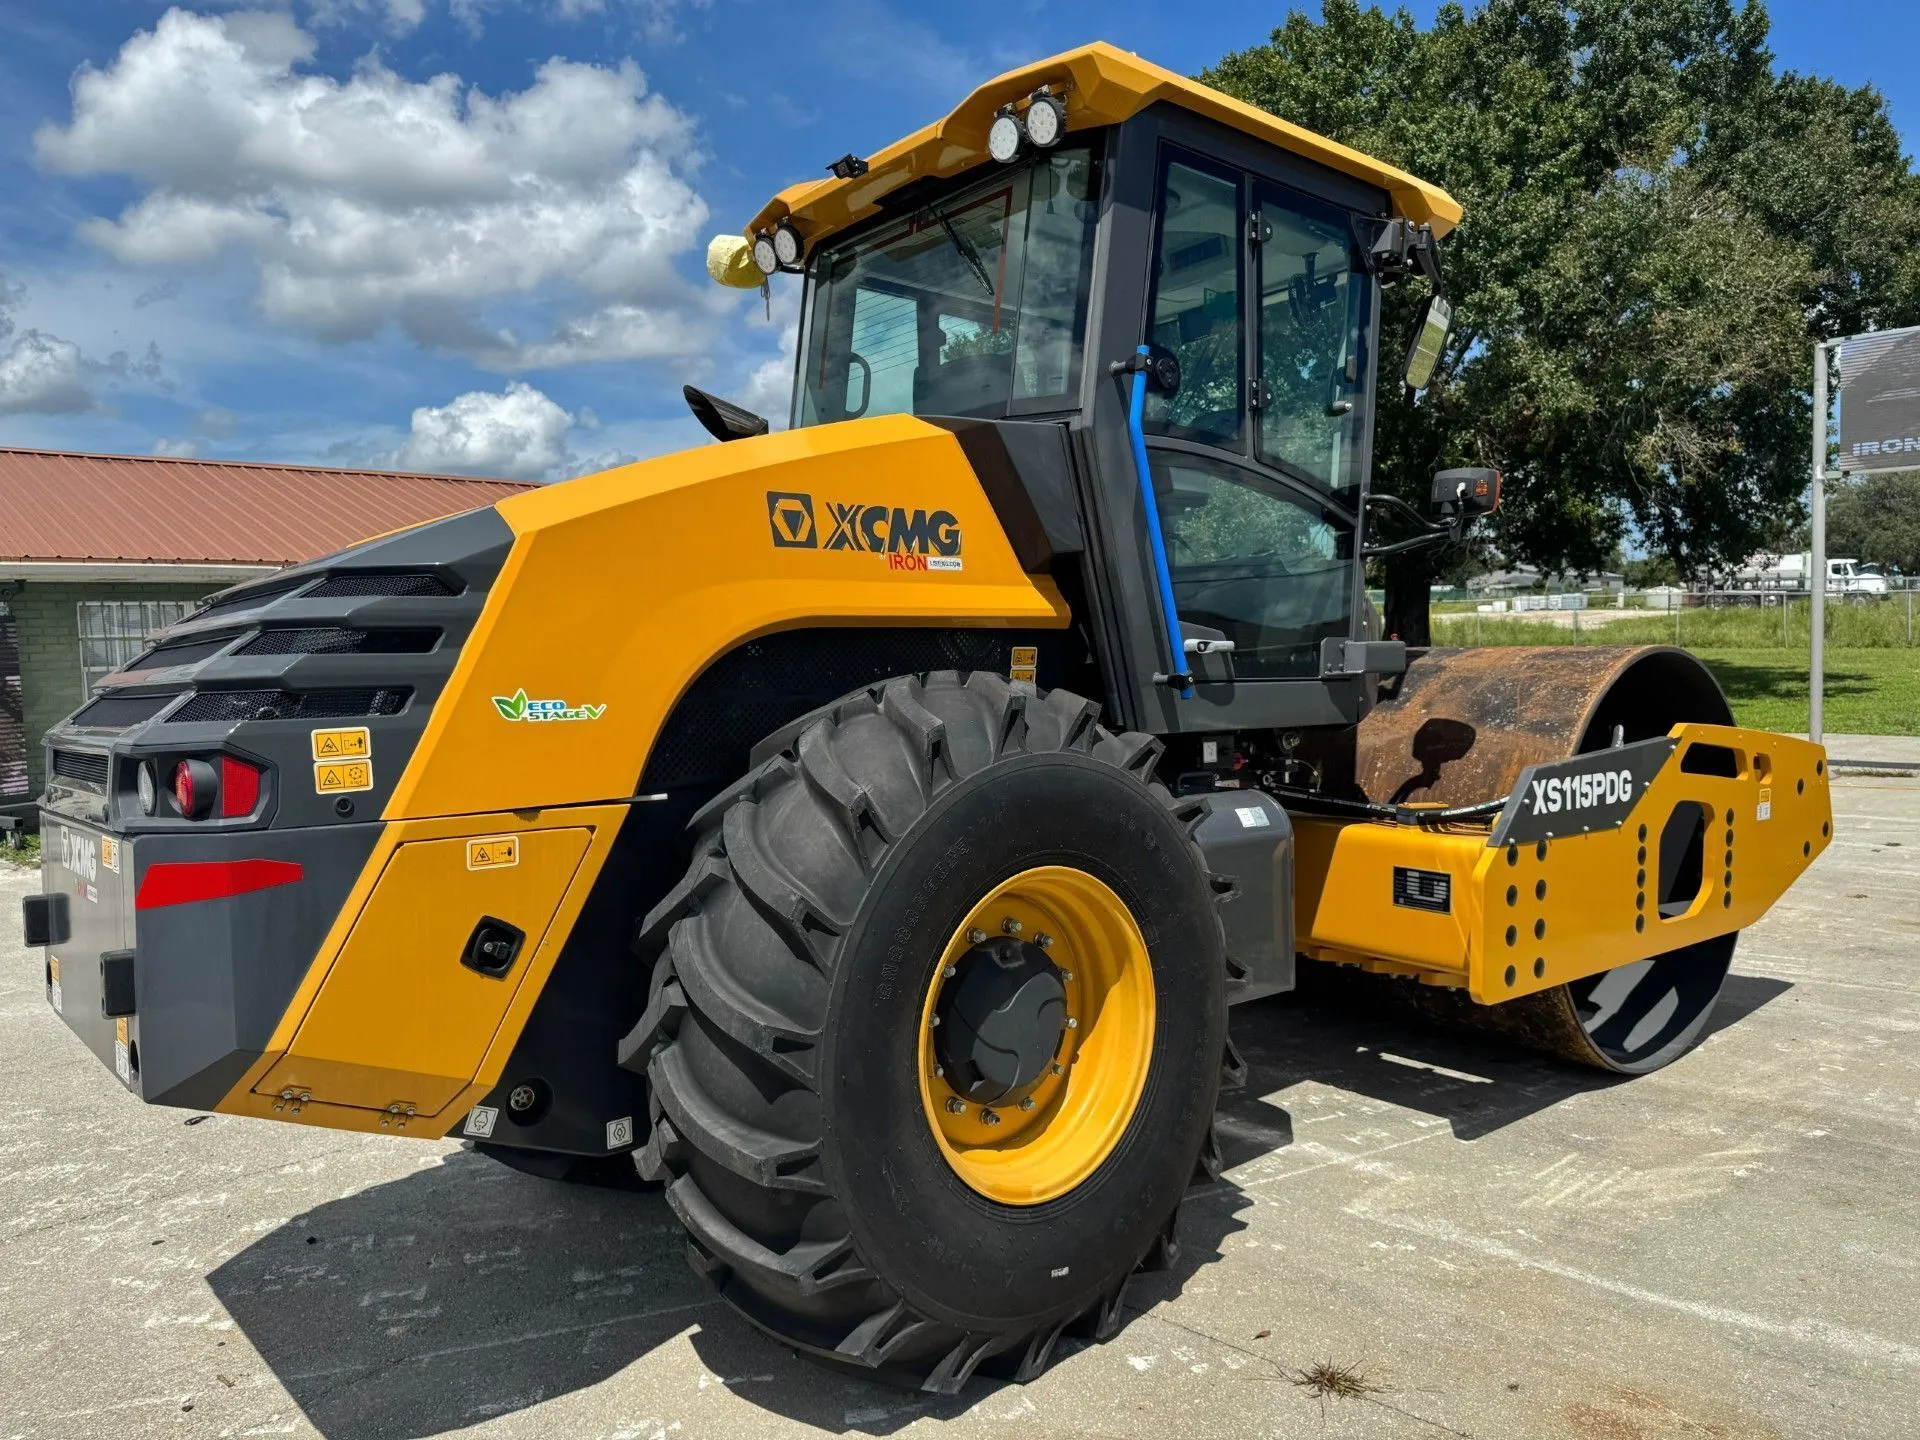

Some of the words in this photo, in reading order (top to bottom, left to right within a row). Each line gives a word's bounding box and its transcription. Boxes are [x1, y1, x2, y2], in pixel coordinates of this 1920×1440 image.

[823, 502, 962, 557] XCMG
[888, 553, 928, 571] IRON
[528, 701, 565, 711] ECO
[1532, 769, 1633, 816] XS115PDG
